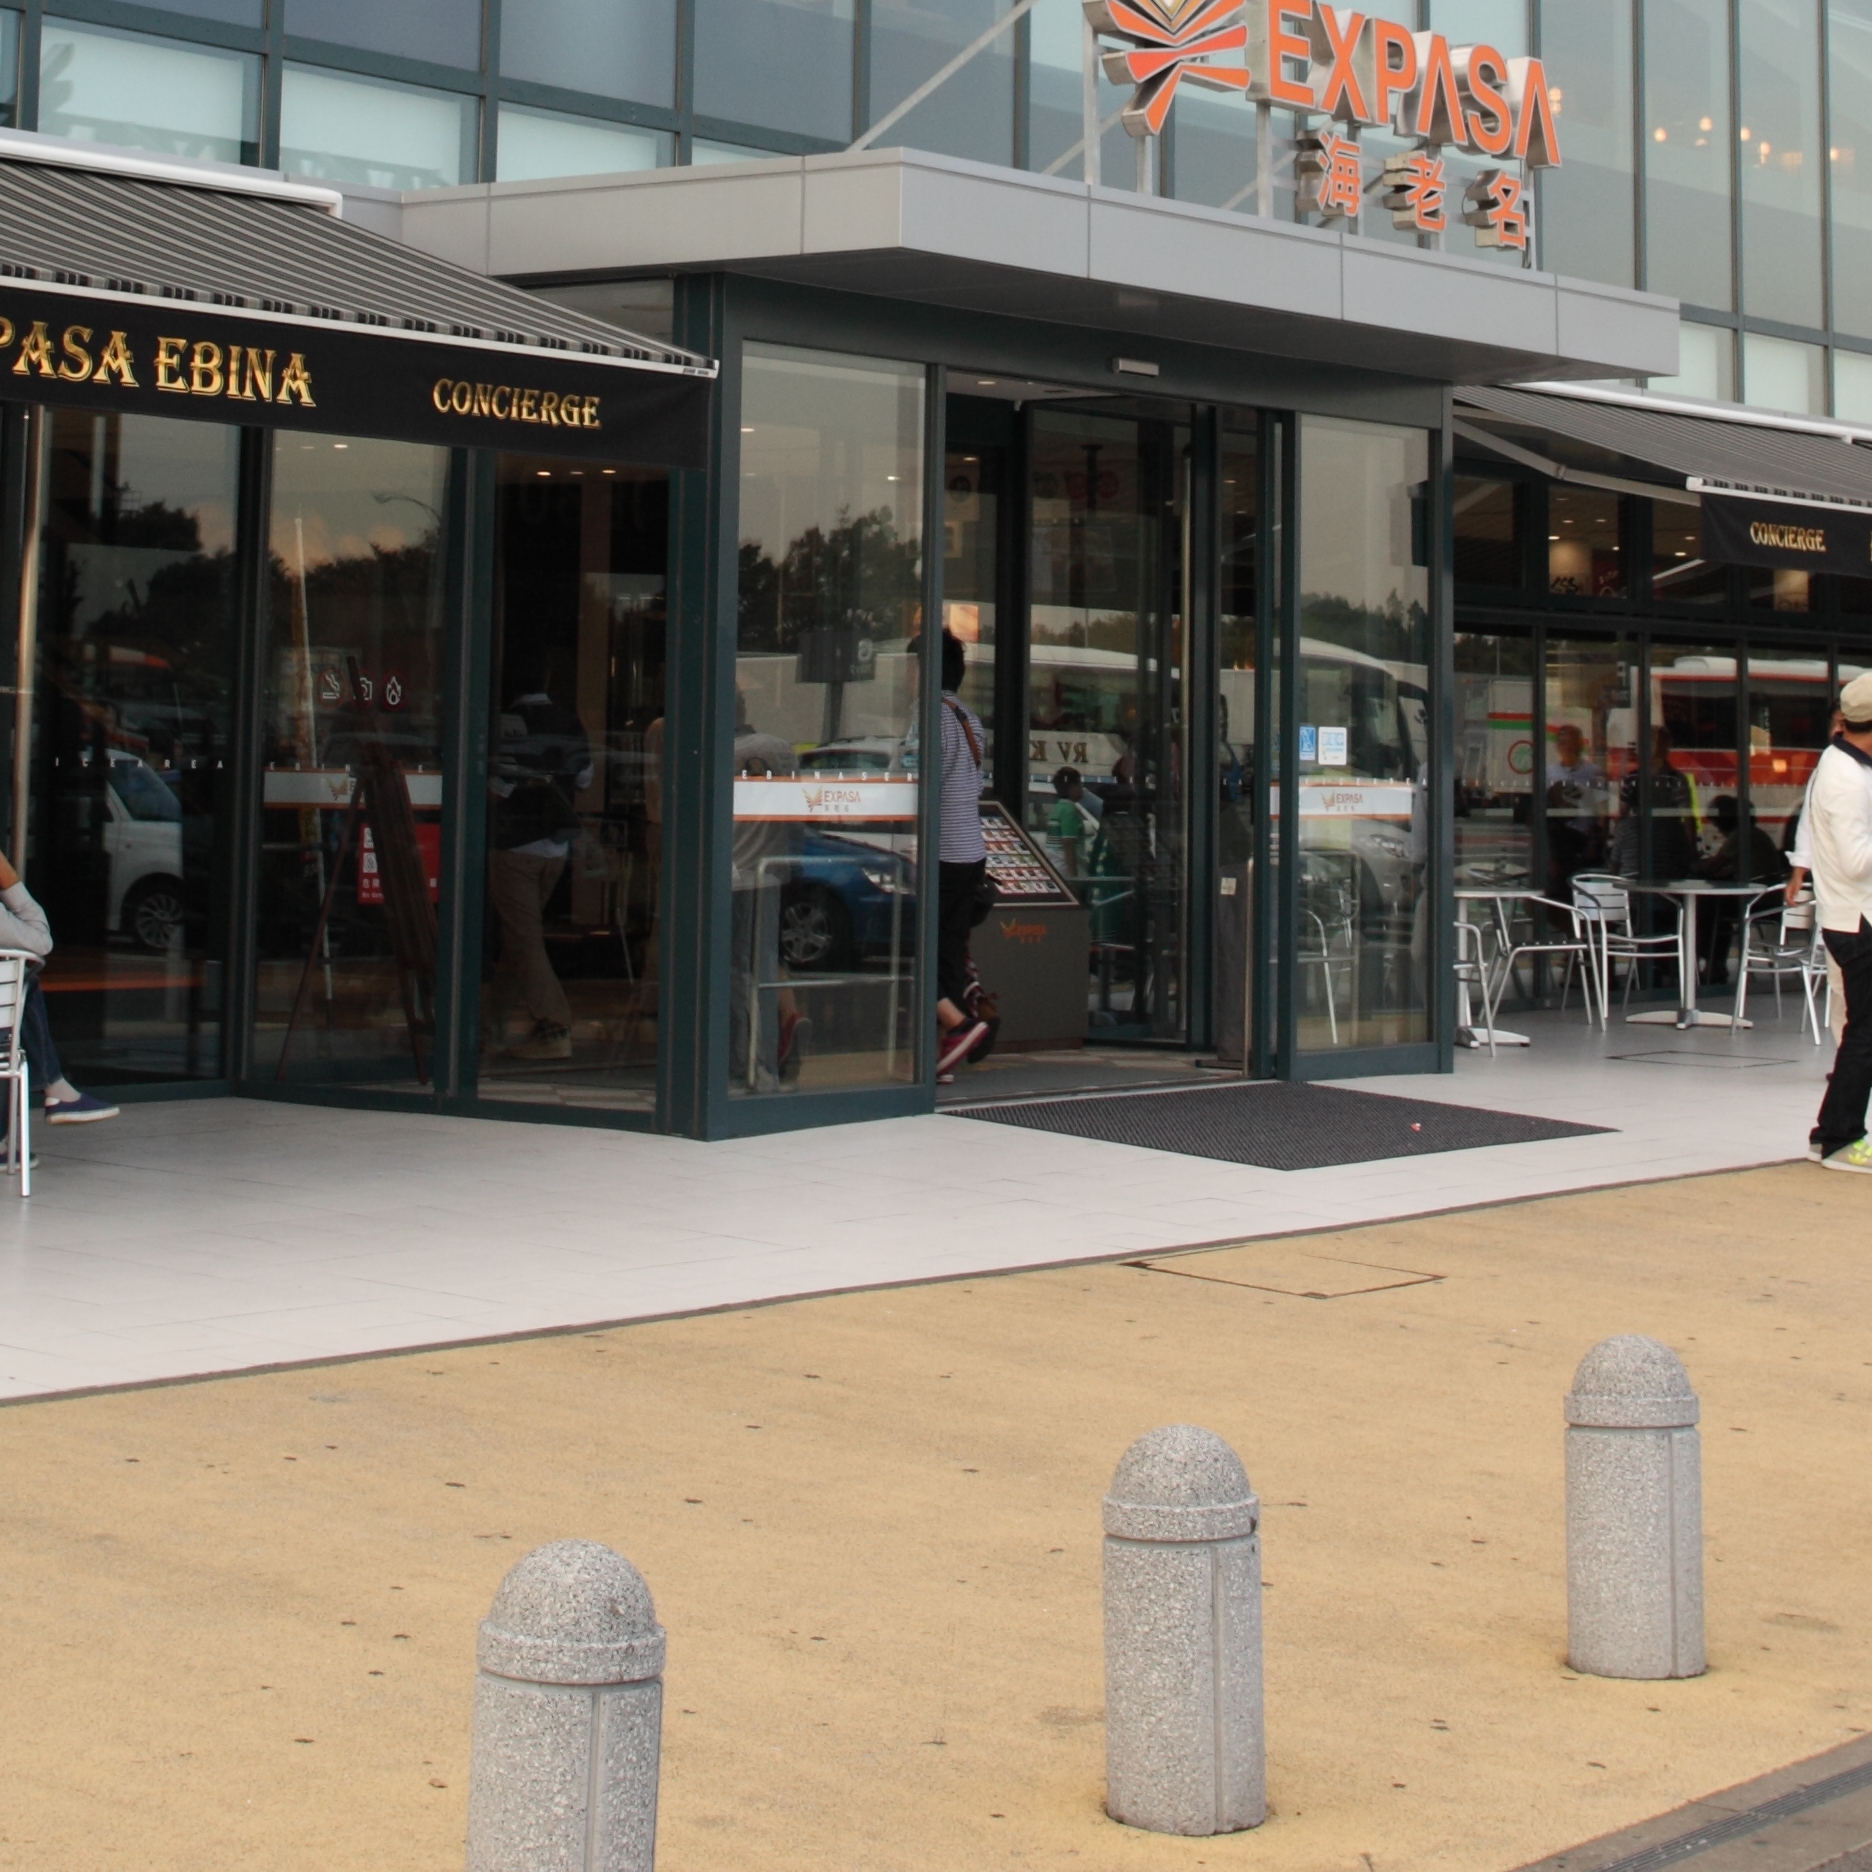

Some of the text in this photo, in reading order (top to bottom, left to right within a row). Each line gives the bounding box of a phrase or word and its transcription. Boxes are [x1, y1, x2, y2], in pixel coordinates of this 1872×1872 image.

[1298, 129, 1527, 251] 海老名
[153, 337, 318, 408] EBINA
[432, 378, 602, 432] CONCIERGE
[1749, 520, 1826, 553] CONCIERGE
[823, 790, 861, 804] EXPASA
[1335, 792, 1364, 805] EXPASA
